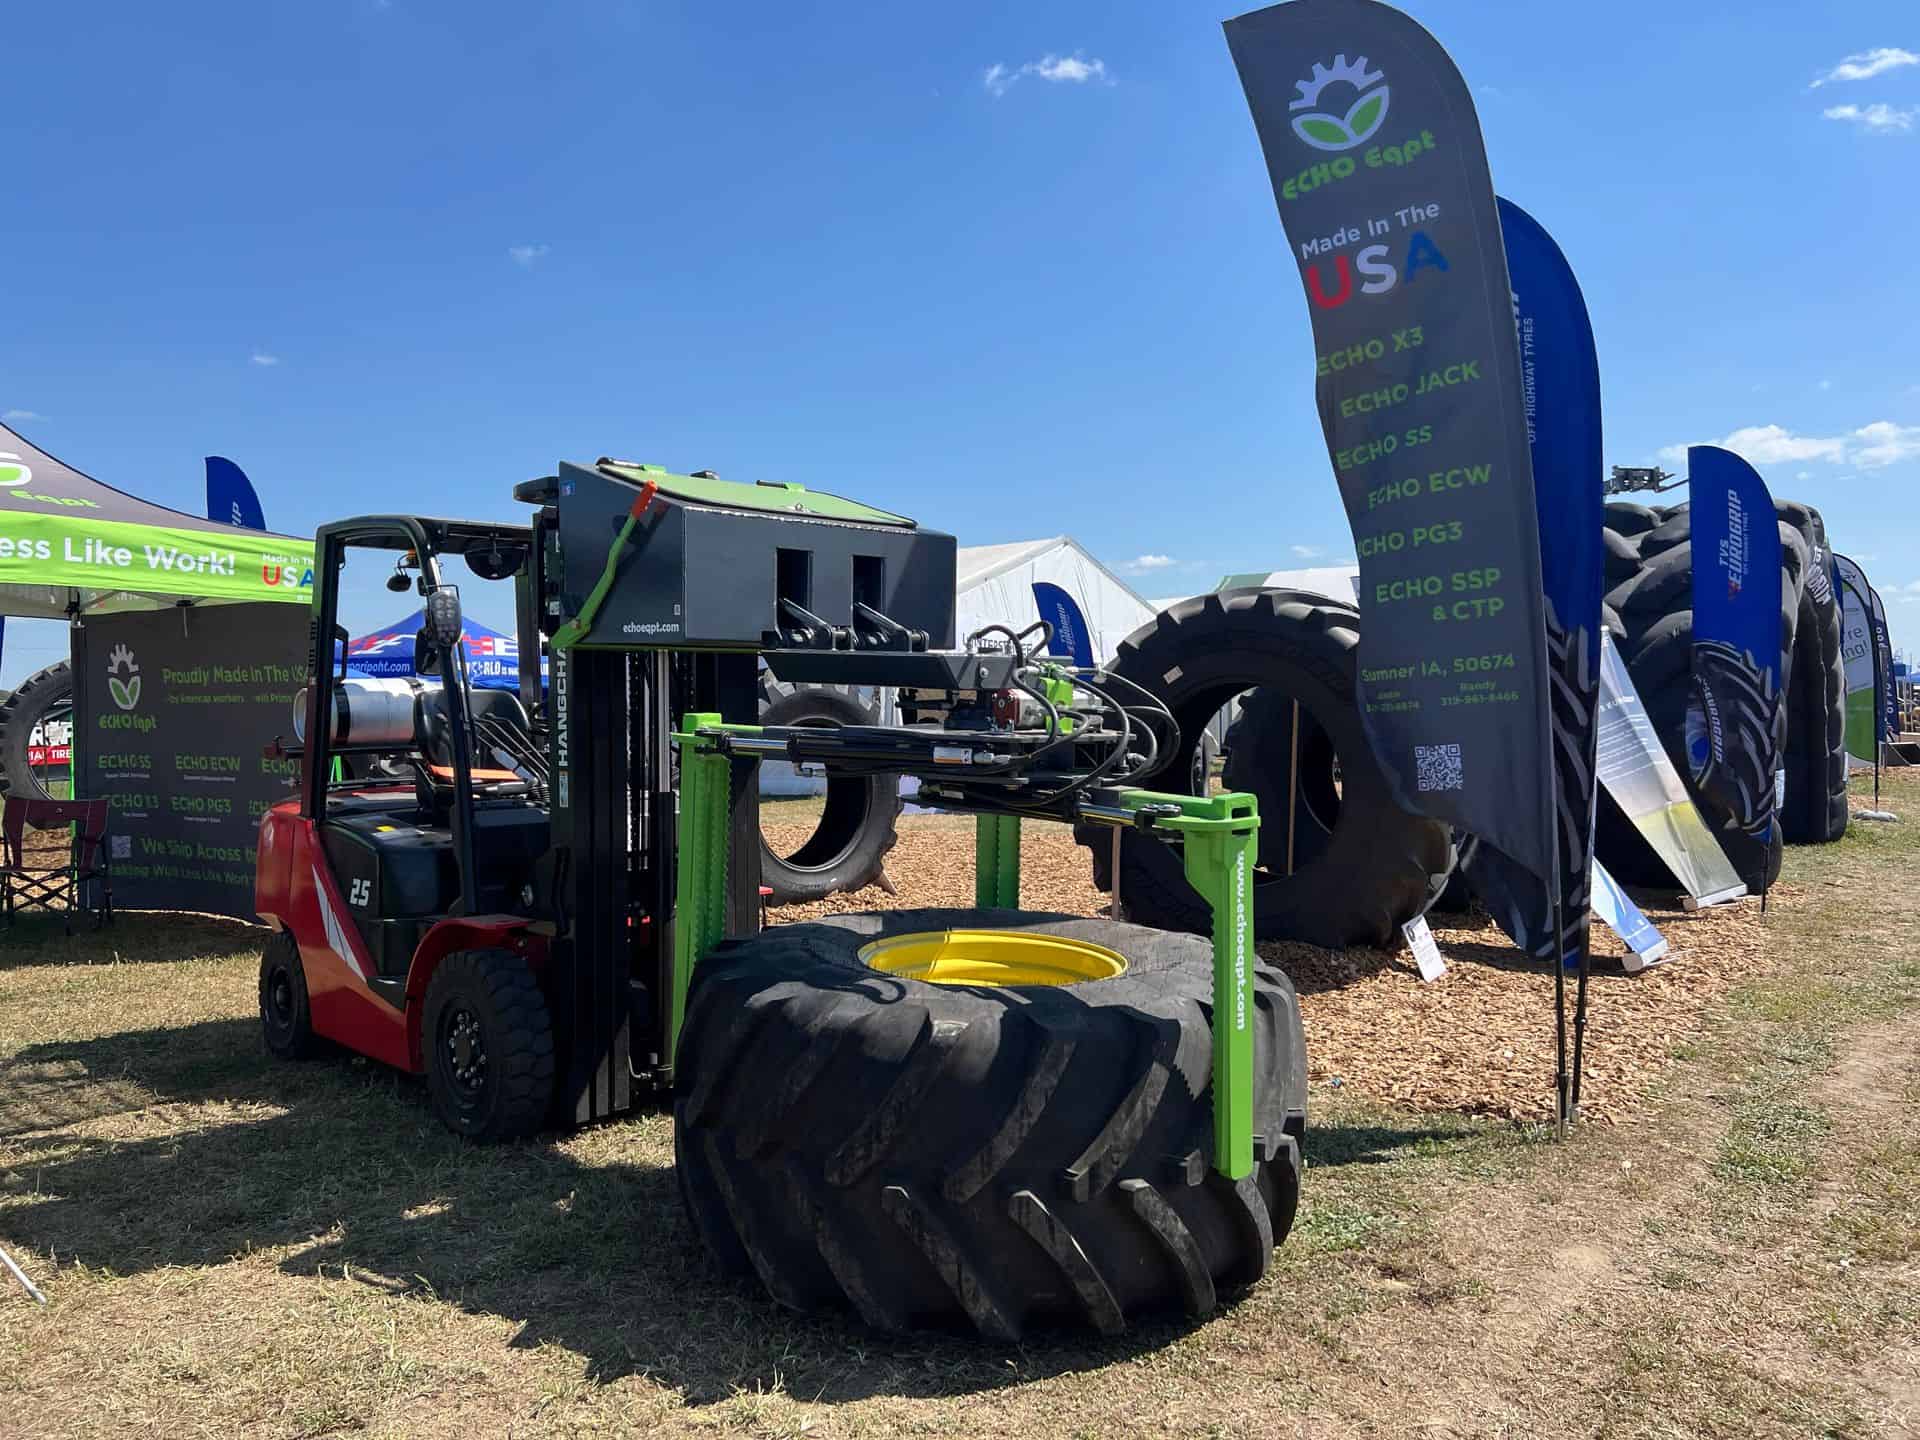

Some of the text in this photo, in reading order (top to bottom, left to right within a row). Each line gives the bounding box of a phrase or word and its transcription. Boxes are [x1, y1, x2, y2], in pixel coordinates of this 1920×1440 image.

[1282, 130, 1436, 200] ECHO Eqpt
[1301, 203, 1440, 260] Made In The
[1305, 230, 1449, 310] USA
[1317, 326, 1424, 376] ECHO X3
[1523, 317, 1533, 357] TYRES
[1340, 360, 1481, 418] ECHO JACK
[1525, 361, 1536, 418] HIGHWAY
[1337, 425, 1432, 470] ECHO SS
[1429, 463, 1492, 492] ECW
[64, 536, 132, 567] Like
[144, 544, 235, 576] Work!
[1357, 521, 1463, 560] CHO PG3
[1720, 539, 1728, 566] TVS
[1728, 489, 1742, 589] EUROGRIP
[264, 566, 314, 588] USA
[302, 556, 314, 565] Th
[1376, 567, 1501, 604] ECHO SSP
[1432, 598, 1504, 621] & CTP
[623, 621, 680, 636] echoeqpt.com
[162, 667, 208, 685] Proudly
[213, 666, 249, 682] Made
[250, 666, 263, 682] In
[263, 665, 290, 682] The
[1361, 654, 1515, 684] Sumner IA, 50674
[99, 713, 132, 729] ECHO
[557, 648, 569, 767] HANGCHA
[98, 754, 137, 769] ECHO
[176, 755, 240, 772] ECHO ECW
[171, 796, 231, 814] ECHO PG3
[350, 878, 371, 906] 25
[1236, 850, 1248, 1031] www.echoeqpt.com
